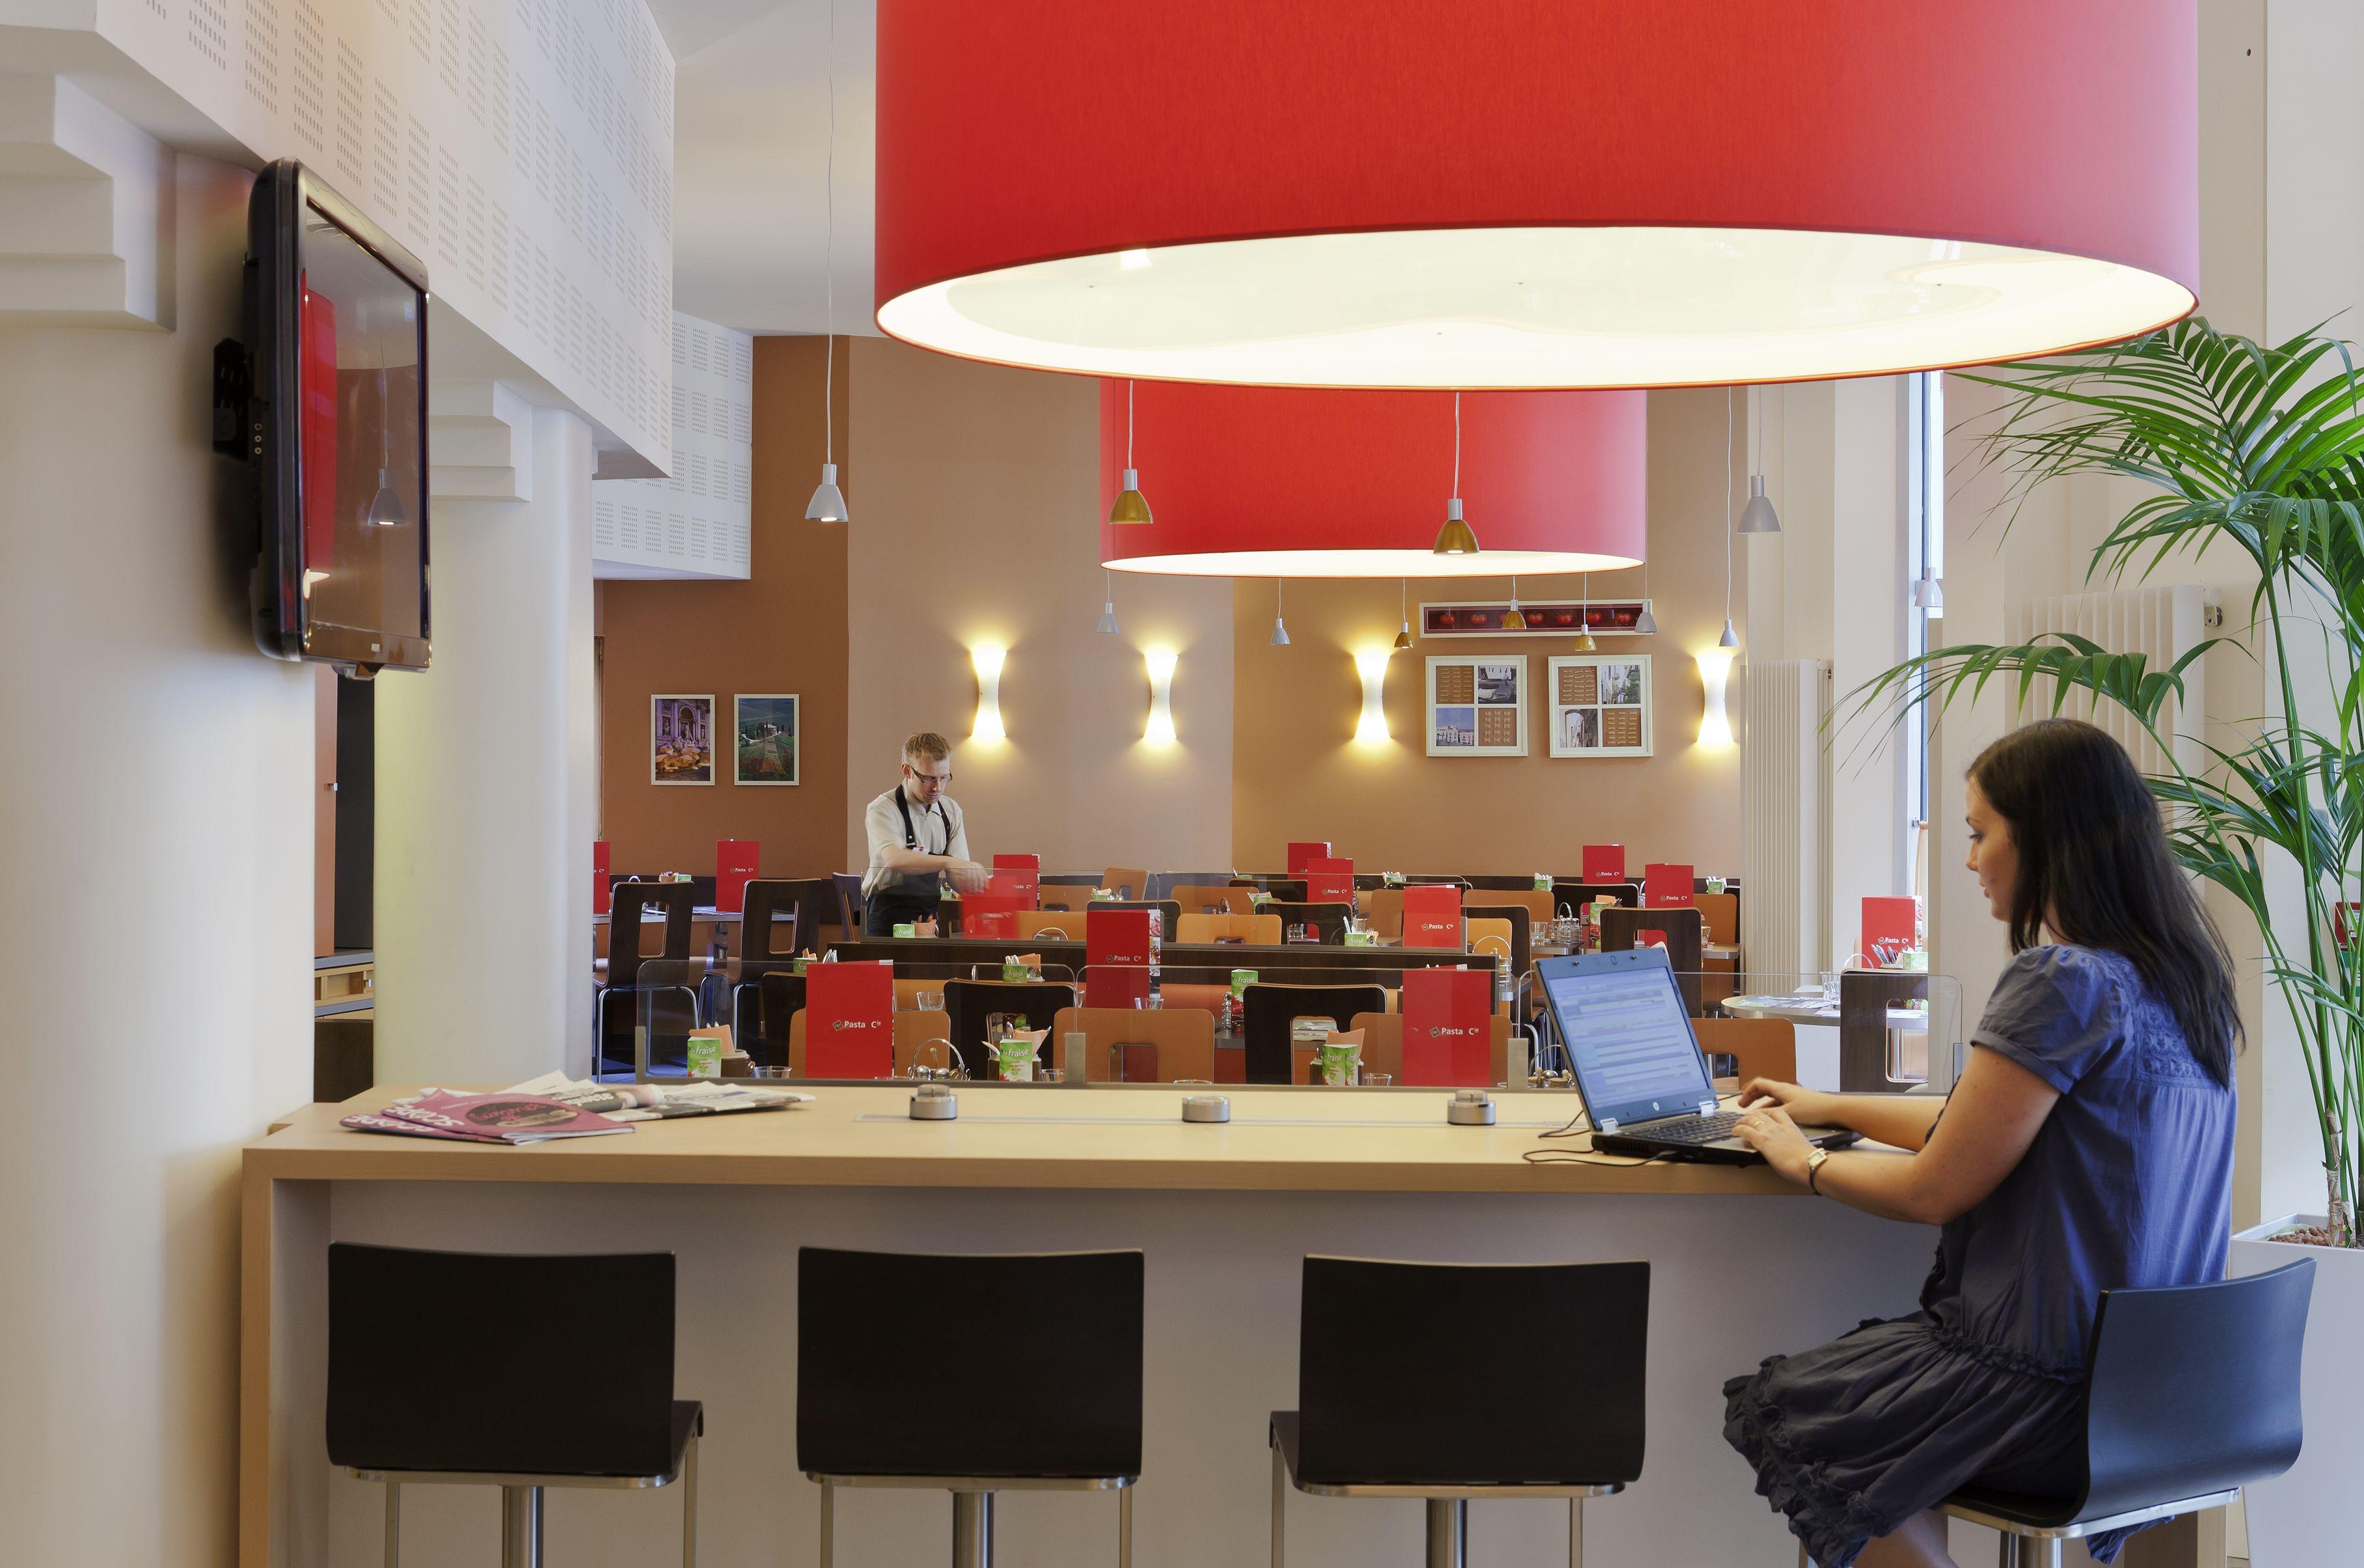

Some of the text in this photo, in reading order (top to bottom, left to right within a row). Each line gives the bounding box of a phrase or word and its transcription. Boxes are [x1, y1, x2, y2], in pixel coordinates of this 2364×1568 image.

[696, 1046, 717, 1055] fraise
[1008, 1048, 1029, 1057] fraise
[1327, 1052, 1343, 1062] fraise
[385, 1104, 465, 1126] SCOPE
